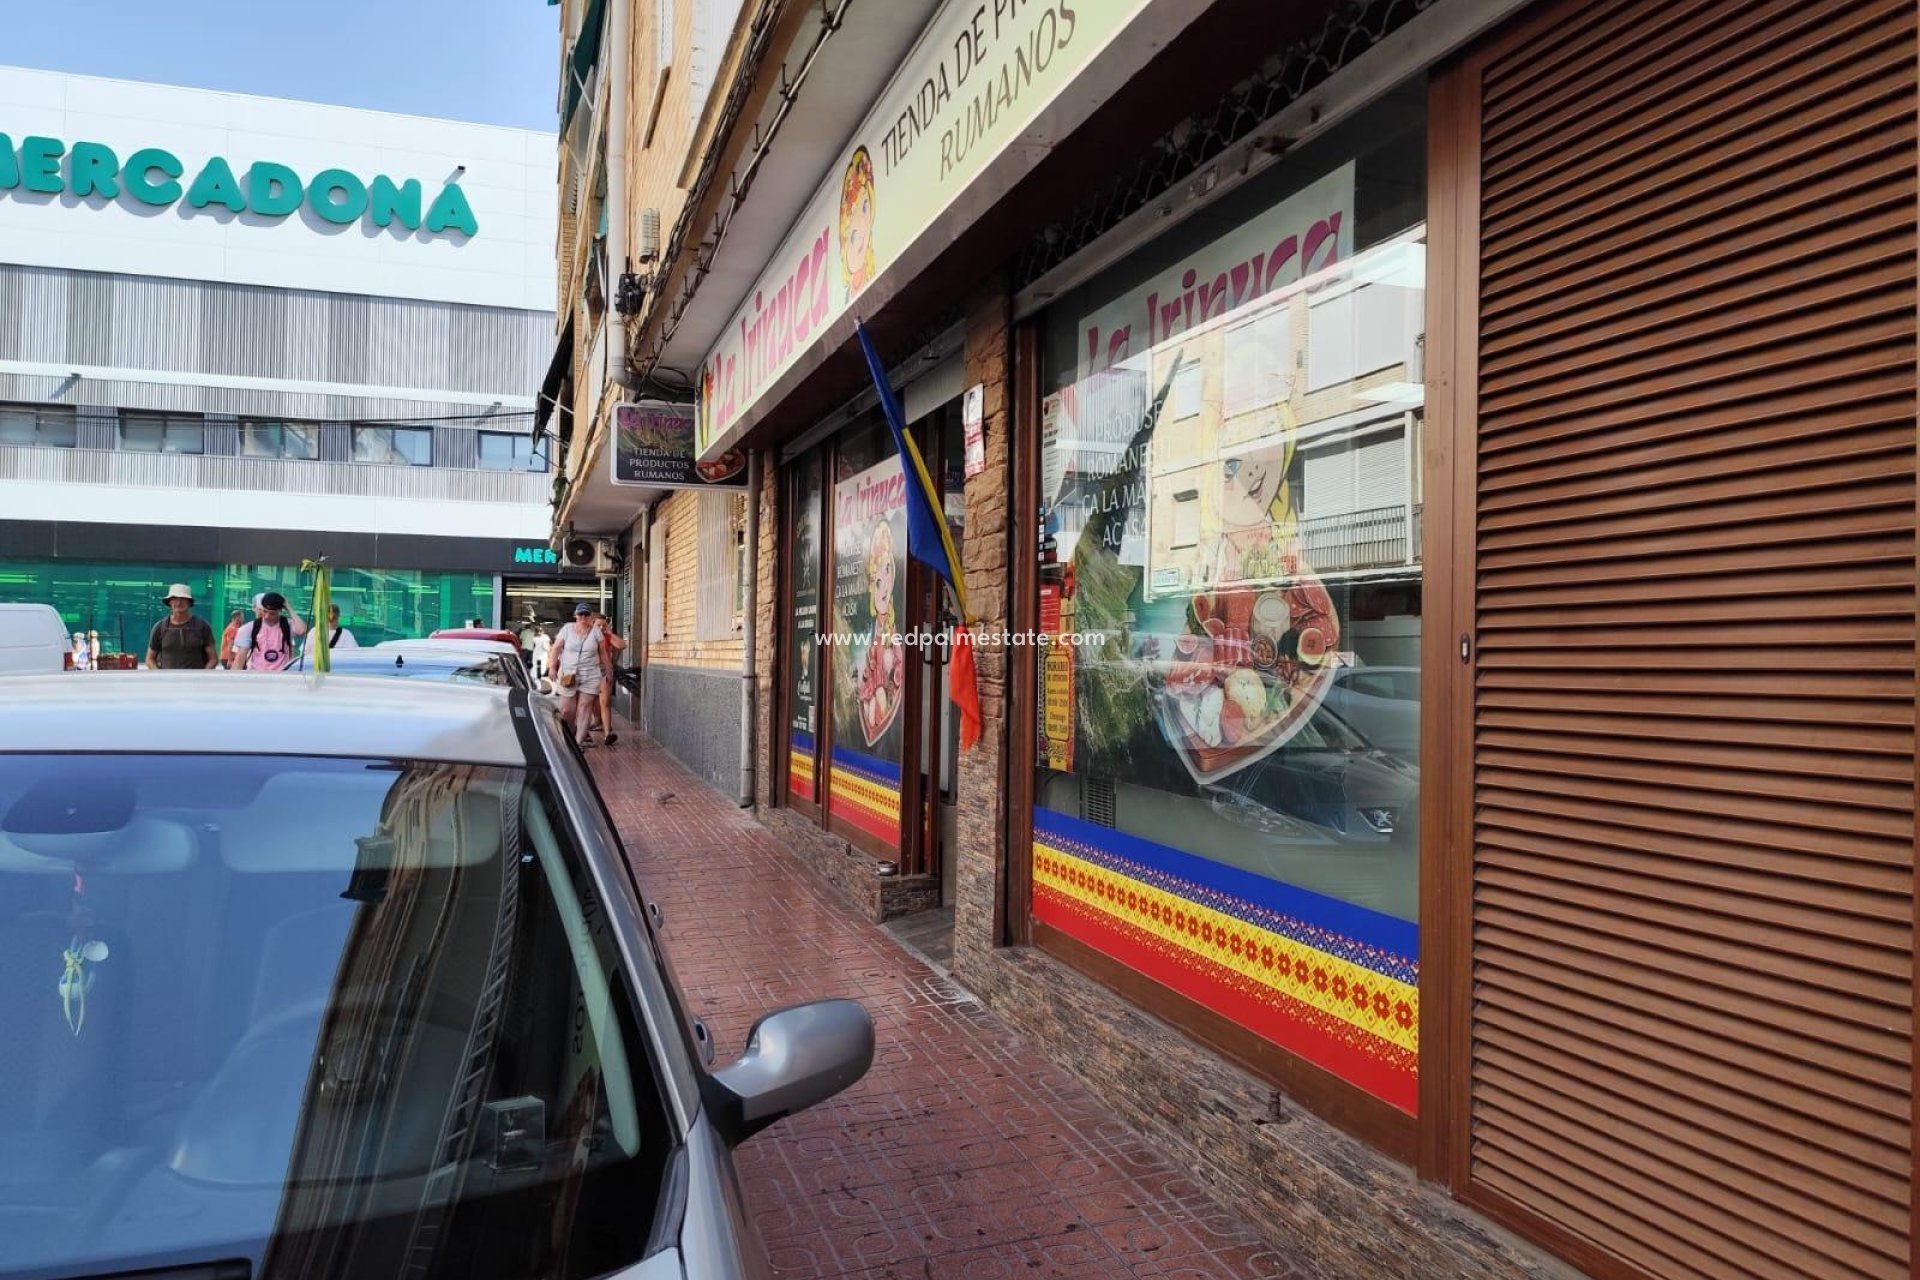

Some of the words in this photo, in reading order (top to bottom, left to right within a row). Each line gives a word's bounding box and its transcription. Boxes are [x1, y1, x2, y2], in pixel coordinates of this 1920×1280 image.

[881, 62, 951, 177] TIENDA
[954, 4, 987, 88] DE
[940, 0, 1076, 182] RUMANOS
[714, 351, 736, 431] La
[741, 226, 830, 404] Irinuca
[629, 458, 689, 469] PRODUCTOS
[633, 447, 670, 457] TIENDA
[672, 449, 686, 458] DE
[634, 470, 685, 480] RUMANOS
[1102, 485, 1120, 513] LA
